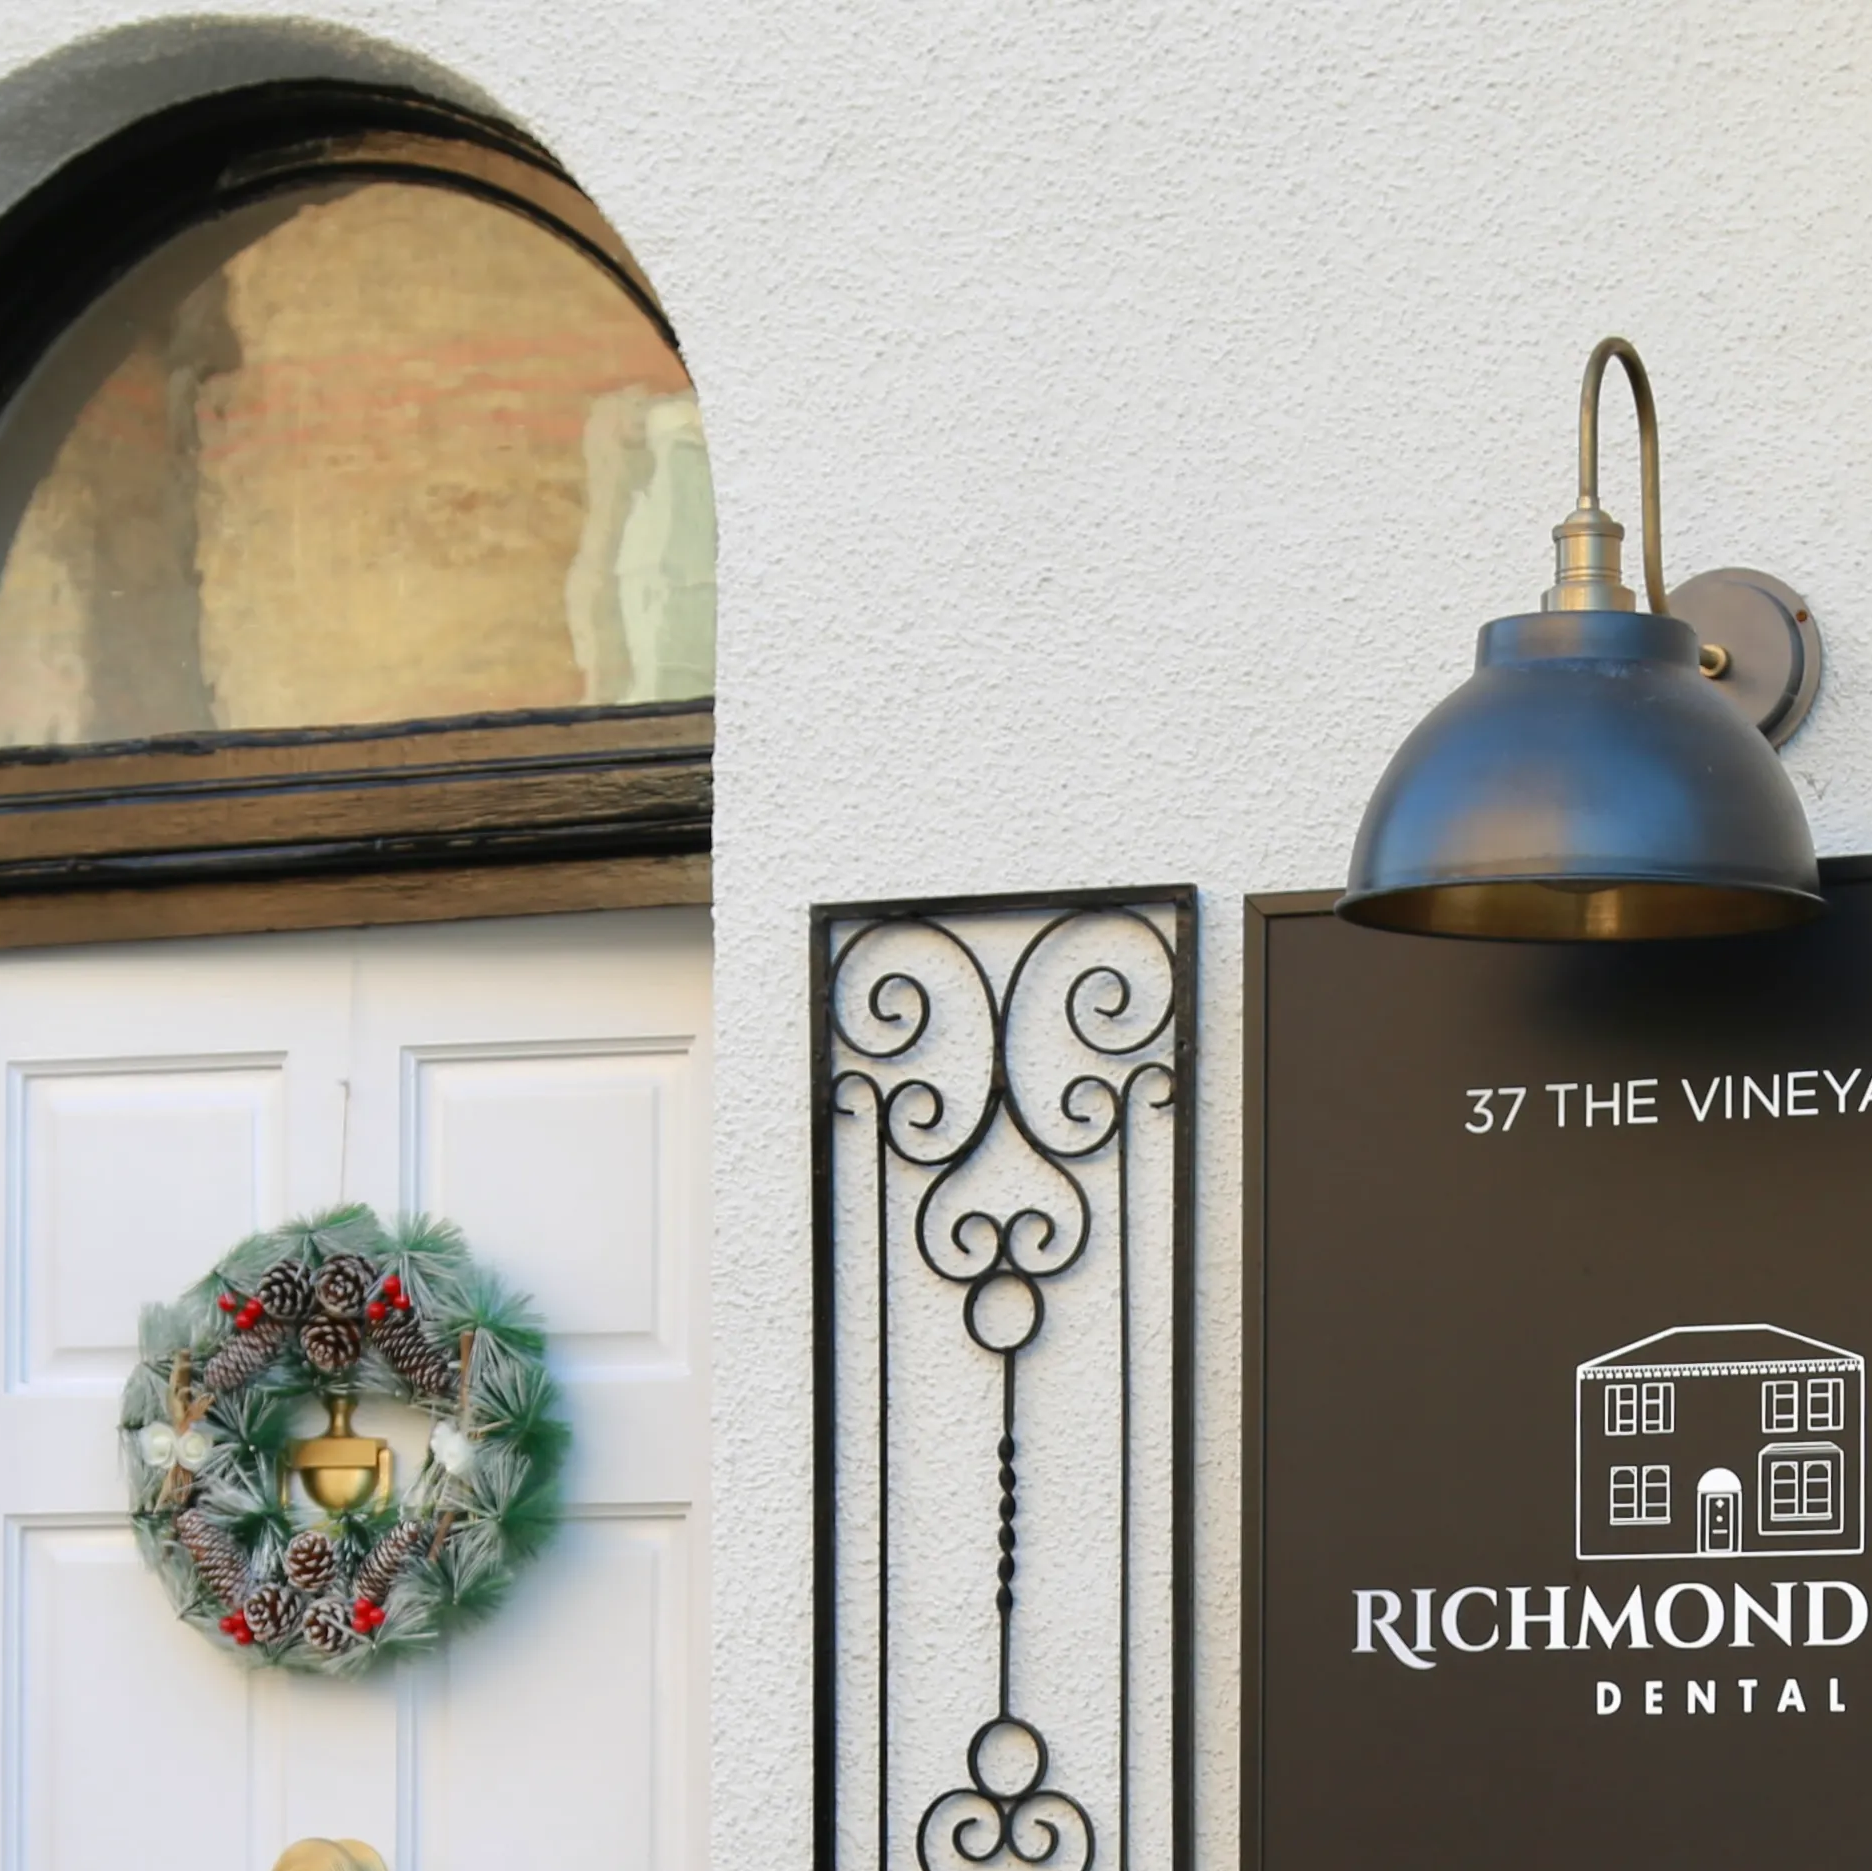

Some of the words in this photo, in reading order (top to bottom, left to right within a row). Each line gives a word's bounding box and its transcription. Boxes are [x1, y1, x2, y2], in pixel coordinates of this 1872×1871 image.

[1465, 1087, 1527, 1134] 37
[1545, 1079, 1658, 1127] THE
[1352, 1581, 1868, 1669] RICHMOND
[1597, 1678, 1846, 1716] DENTAL
